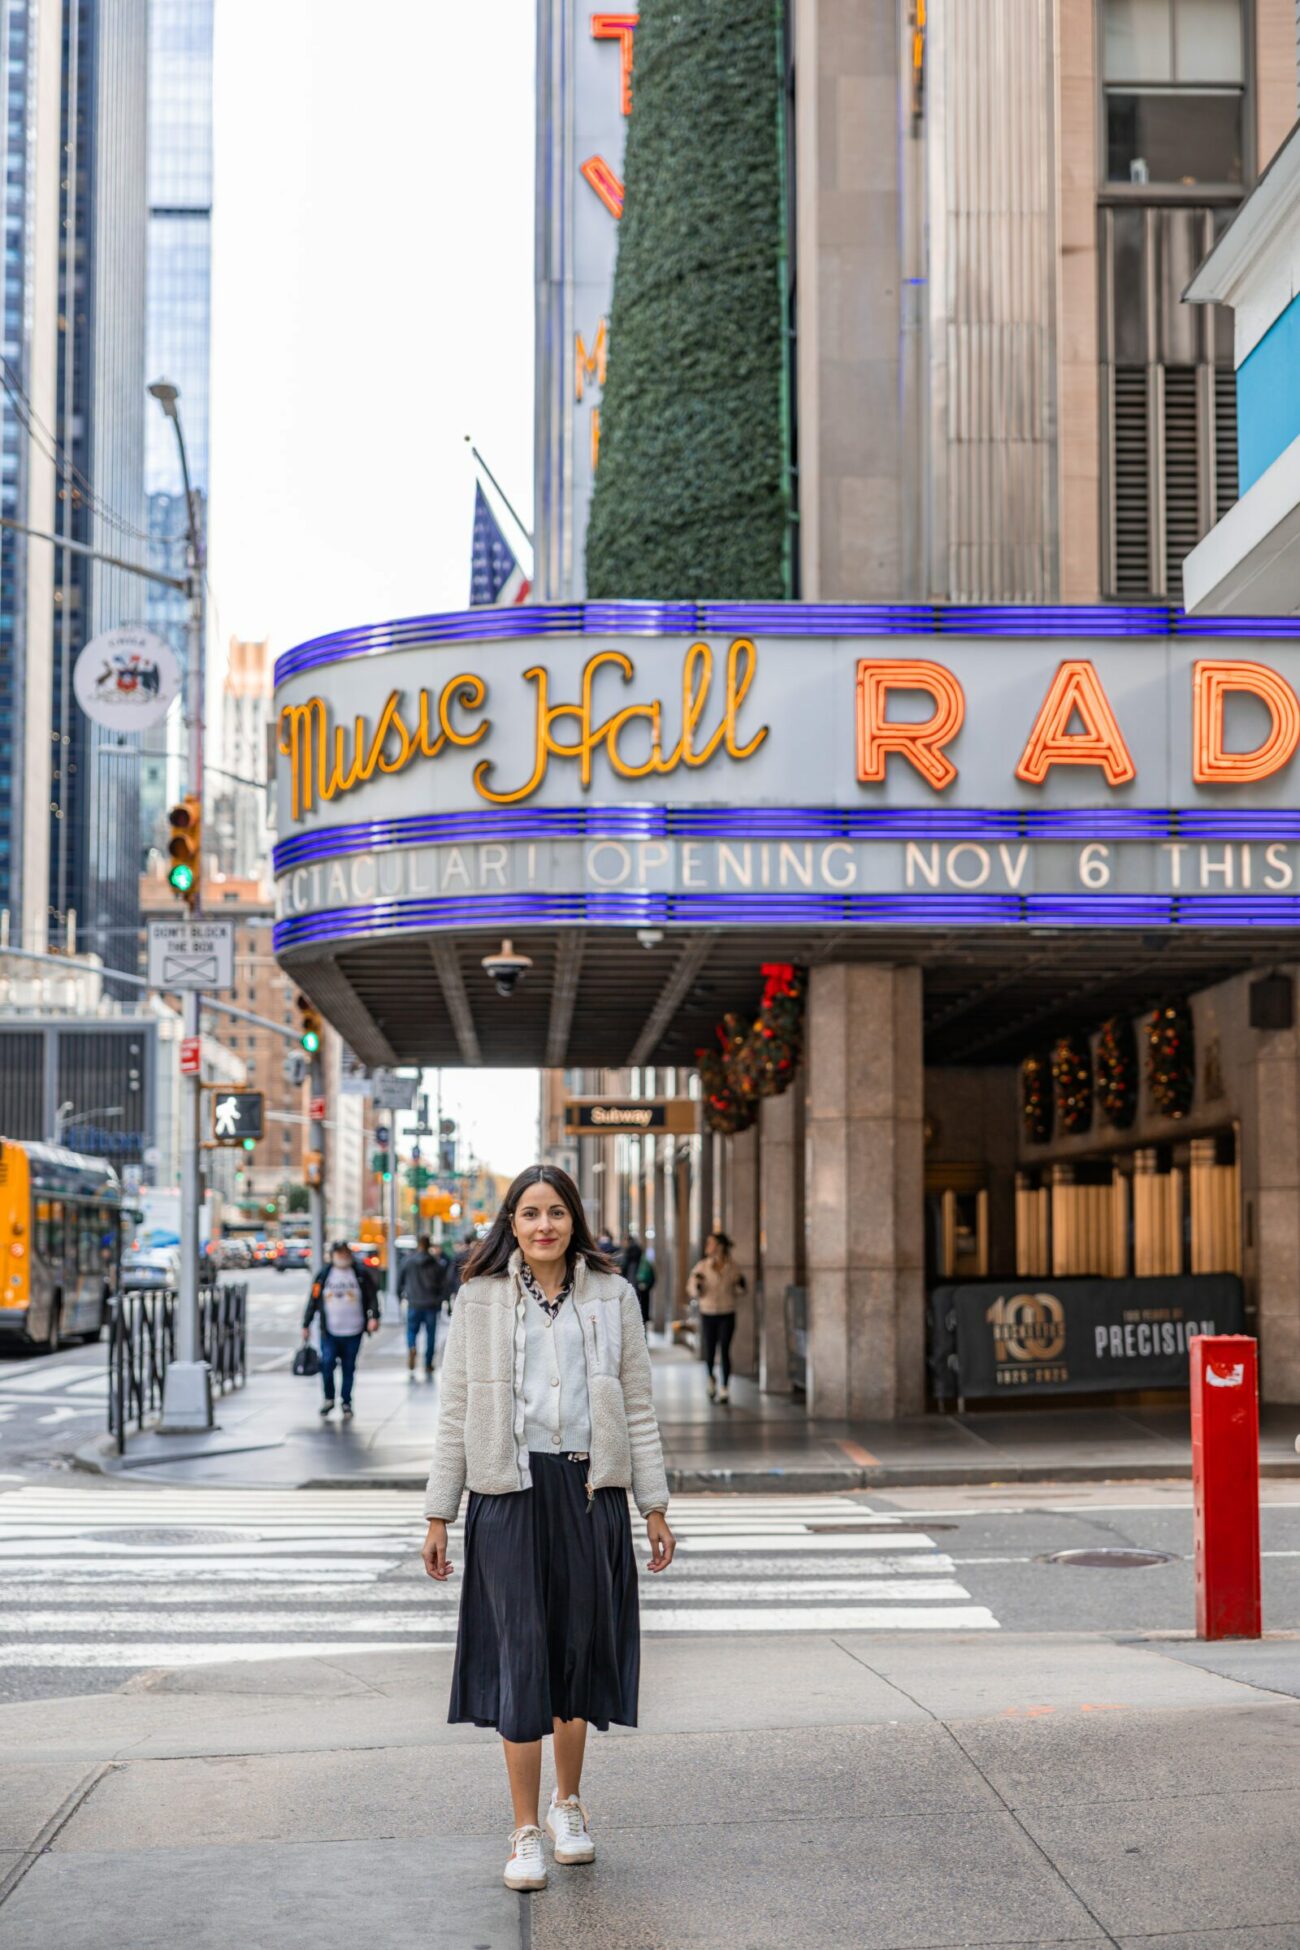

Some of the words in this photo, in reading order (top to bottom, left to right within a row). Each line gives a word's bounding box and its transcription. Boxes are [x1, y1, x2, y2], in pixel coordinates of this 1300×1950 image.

[277, 673, 490, 822] Music
[473, 638, 770, 804] Hall
[856, 658, 1300, 790] RAD
[586, 840, 857, 888] OPENING
[905, 841, 1029, 888] NOV
[1079, 843, 1110, 889] 6
[1161, 843, 1294, 890] THIS
[591, 1106, 653, 1127] Subway
[985, 1293, 1066, 1361] 100
